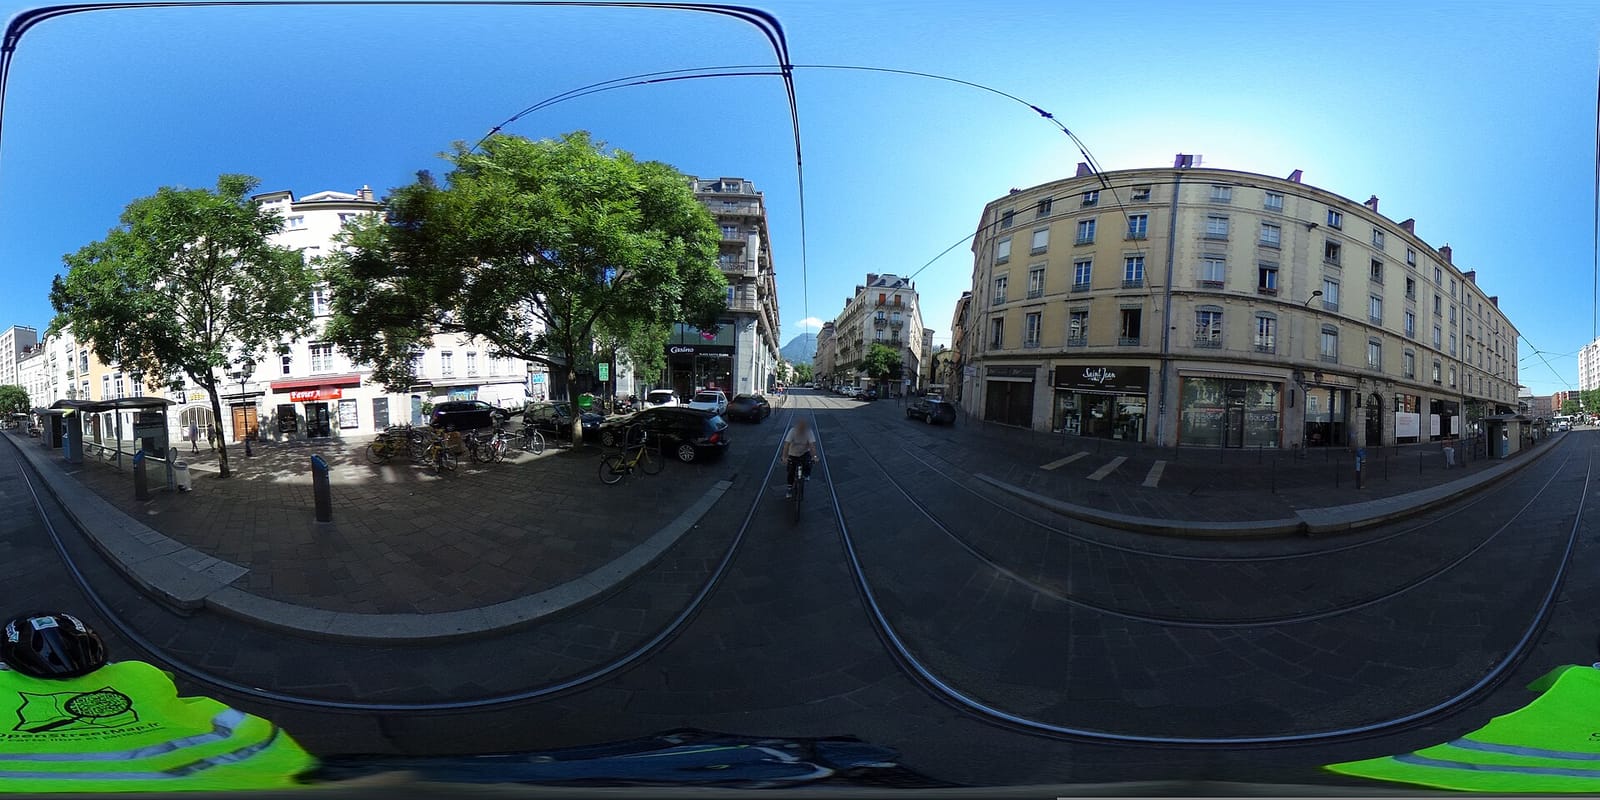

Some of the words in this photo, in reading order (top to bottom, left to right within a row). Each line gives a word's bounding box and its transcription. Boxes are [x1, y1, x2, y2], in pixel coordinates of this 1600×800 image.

[670, 346, 695, 354] Casino
[1082, 367, 1102, 378] Saint
[1100, 367, 1116, 384] Jean
